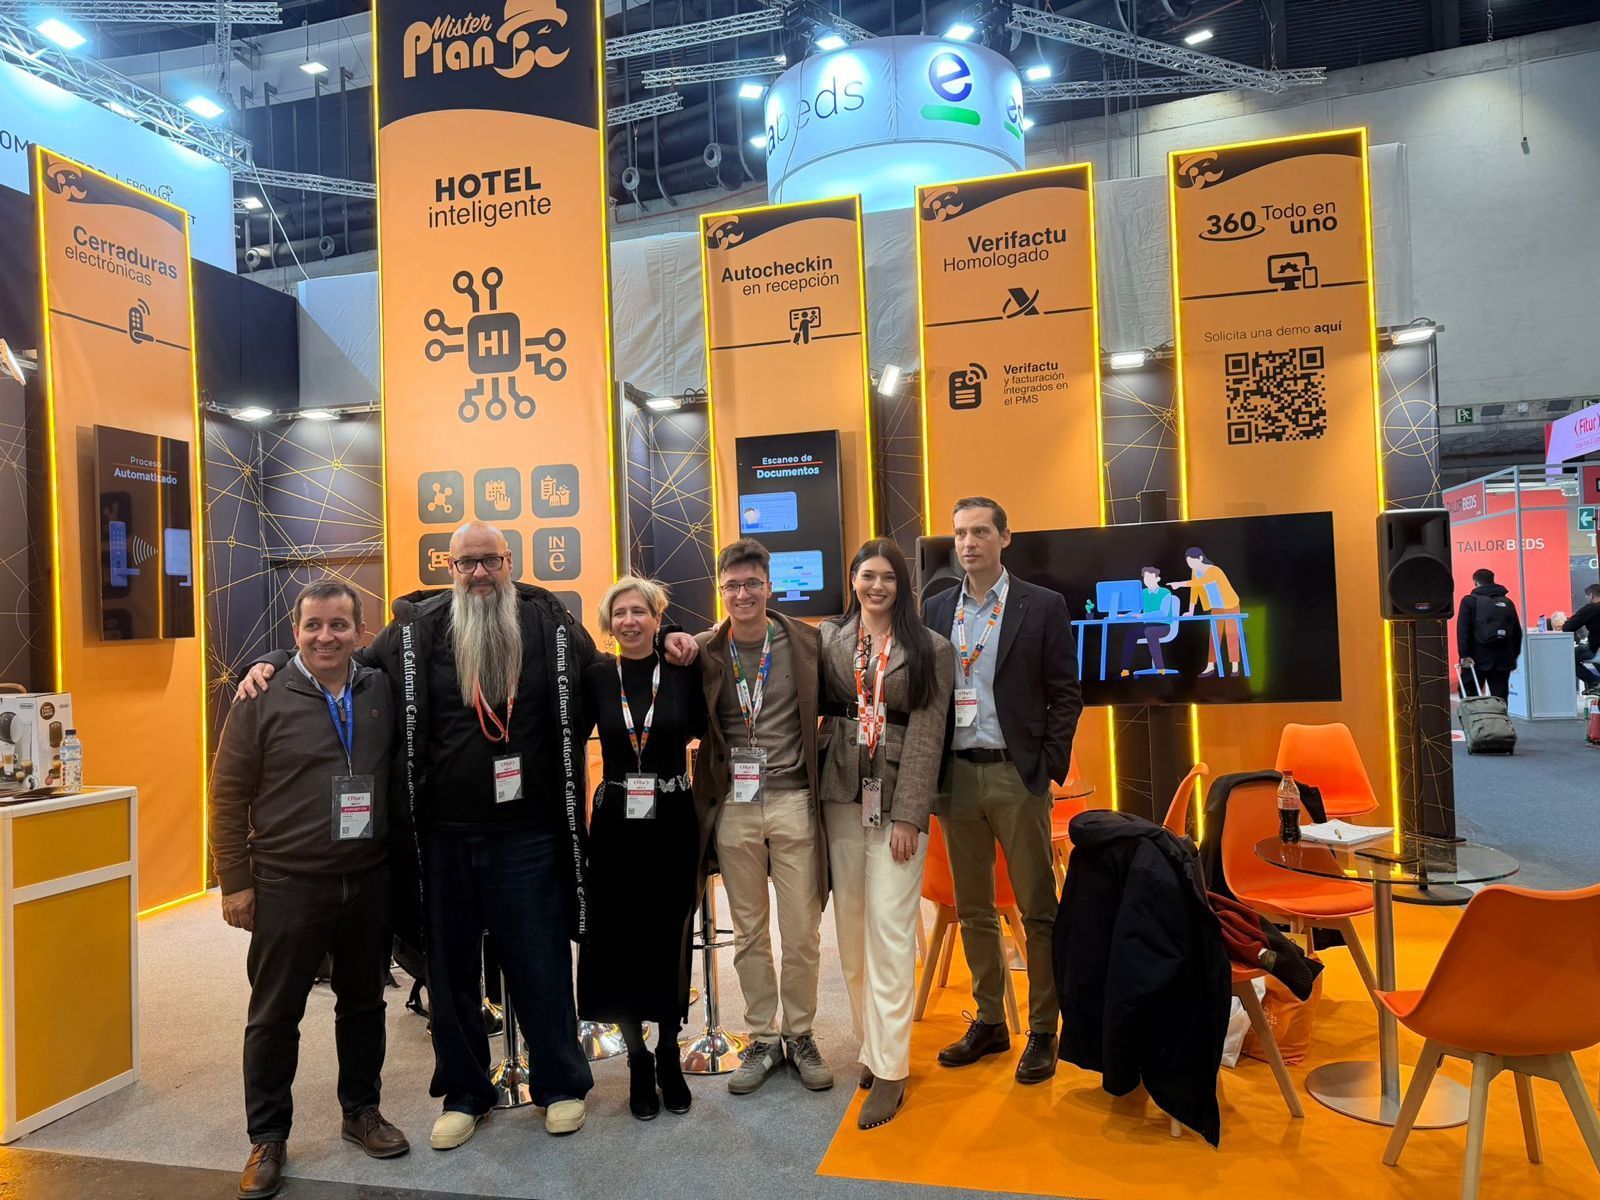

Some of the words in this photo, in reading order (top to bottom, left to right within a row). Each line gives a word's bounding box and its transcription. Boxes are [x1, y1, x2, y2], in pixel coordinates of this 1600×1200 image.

[432, 13, 492, 40] Mister
[435, 166, 542, 203] HOTEL
[428, 195, 552, 229] inteligente
[1206, 211, 1257, 235] 360
[1261, 203, 1306, 222] Todo
[1313, 202, 1336, 215] en
[1290, 216, 1338, 234] uno
[73, 225, 178, 279] Cerraduras
[967, 227, 1067, 254] Verifactu
[65, 245, 152, 286] electrónicas
[721, 256, 833, 283] Autocheckin
[943, 247, 1049, 272] Homologado
[742, 283, 761, 296] en
[766, 271, 840, 293] recepción
[1204, 330, 1247, 343] Solicita
[1250, 328, 1273, 339] una
[1276, 325, 1311, 337] demo
[1313, 320, 1342, 334] aquí
[1003, 361, 1058, 375] Verifactu
[1003, 378, 1010, 388] y
[1011, 371, 1065, 384] facturación
[1003, 383, 1054, 396] integrados
[1056, 381, 1069, 391] en
[1004, 396, 1013, 406] el
[1015, 394, 1039, 405] PMS
[762, 455, 799, 465] Escaneo
[800, 453, 813, 463] de
[114, 466, 178, 486] Automatizado
[756, 466, 820, 479] Documentos
[556, 624, 568, 673] California
[404, 650, 417, 701] California
[558, 675, 570, 726] California
[406, 704, 418, 757] California
[563, 727, 575, 778] California
